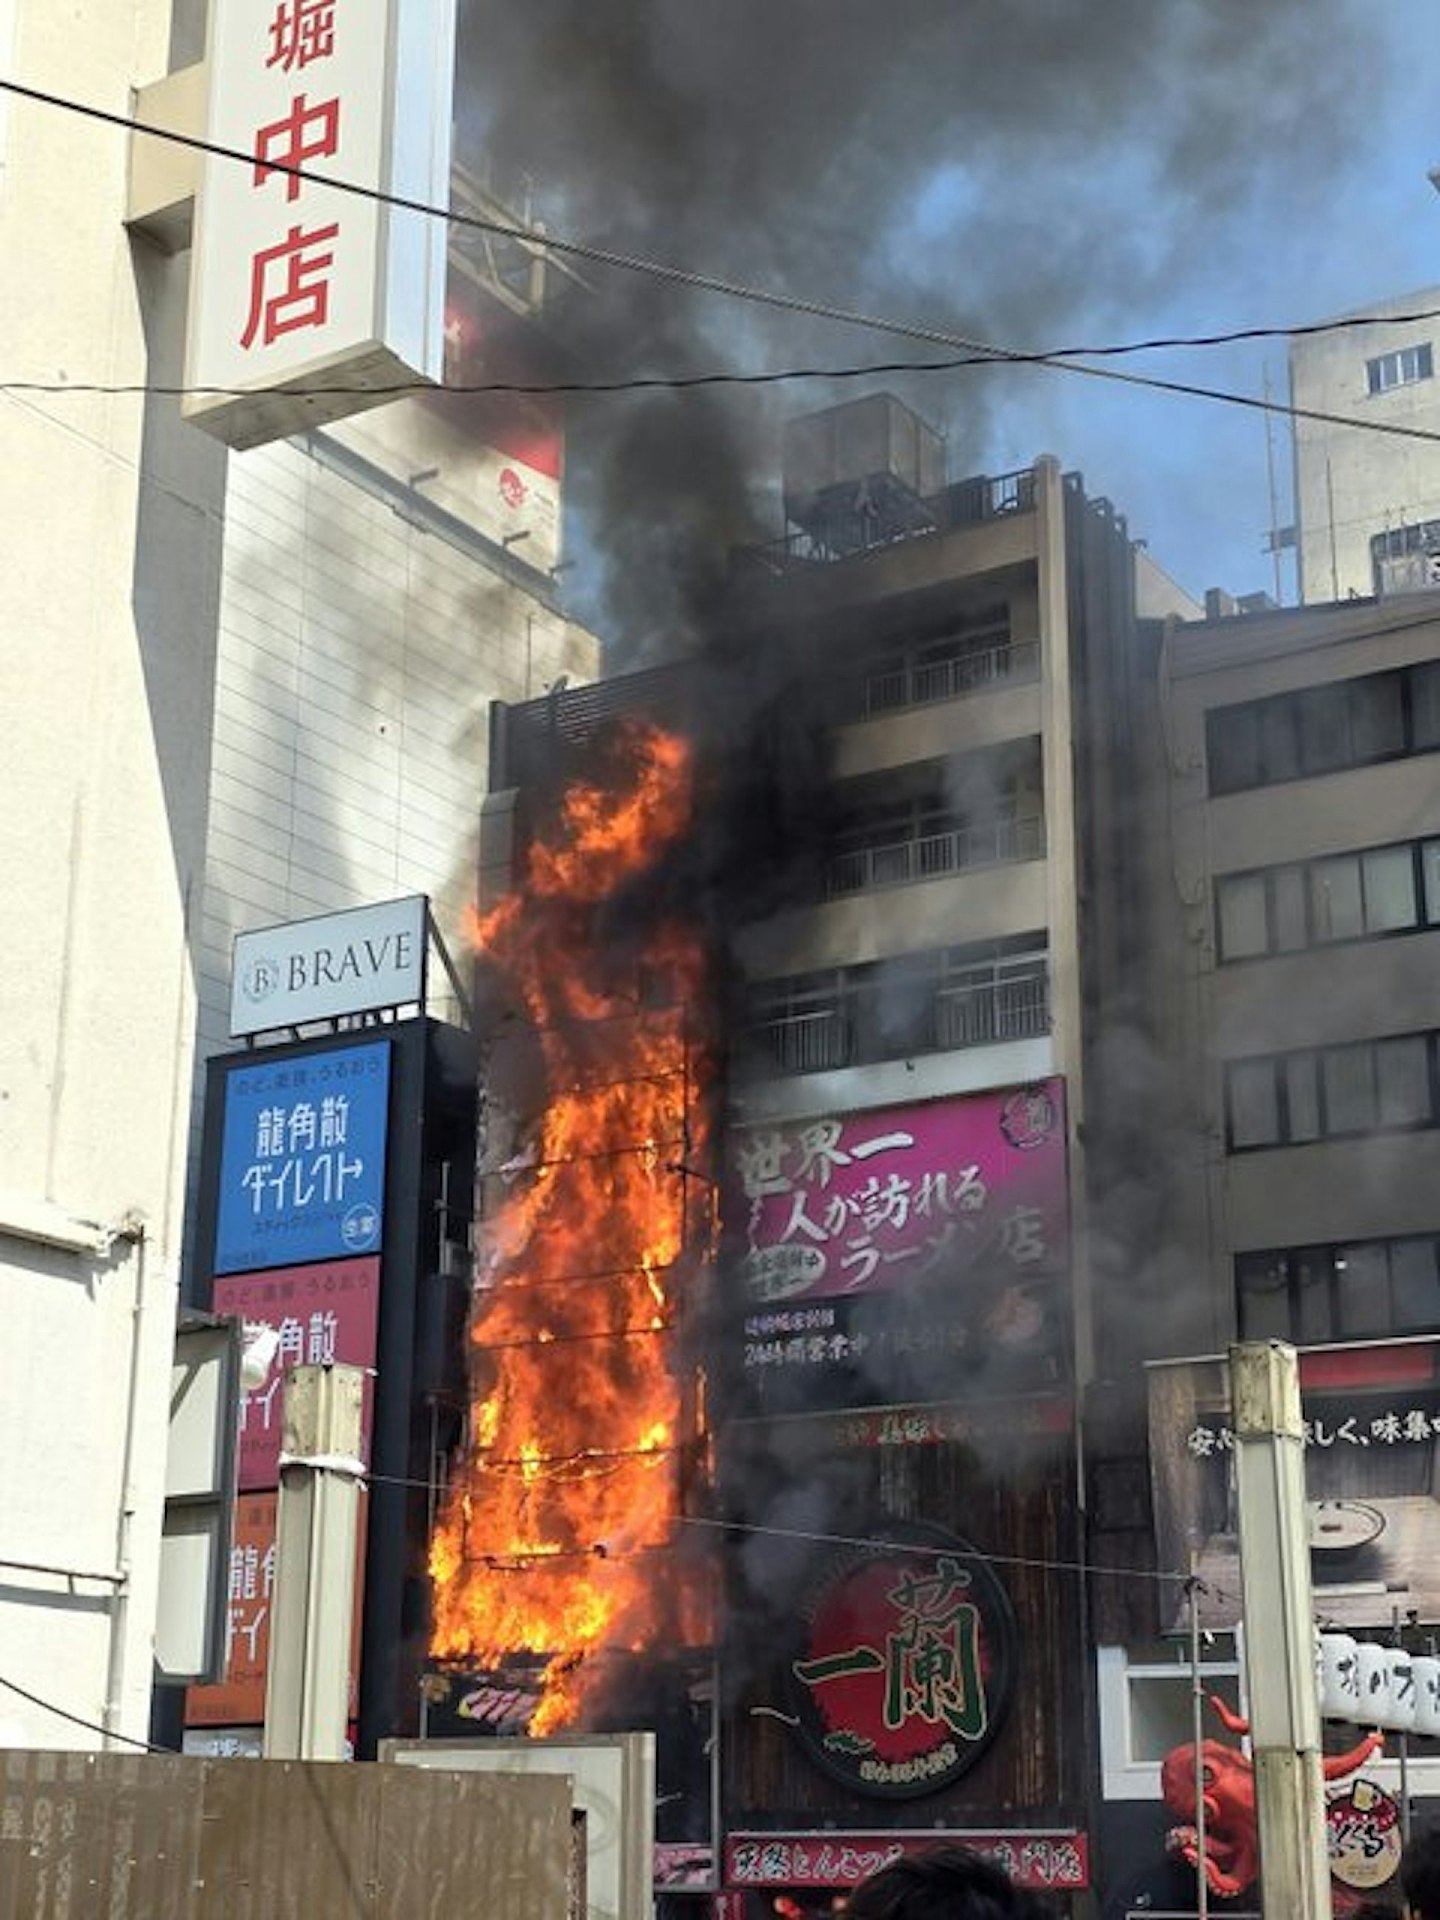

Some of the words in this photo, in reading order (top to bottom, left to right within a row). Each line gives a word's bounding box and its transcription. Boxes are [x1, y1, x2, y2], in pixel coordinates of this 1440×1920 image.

[240, 0, 340, 350] 堀中店
[287, 931, 412, 992] BRAVE
[255, 1094, 350, 1159] 龍角散
[738, 1119, 914, 1197] 世界一
[241, 1151, 363, 1214] ダイレクト
[793, 1557, 987, 1741] 一蘭
